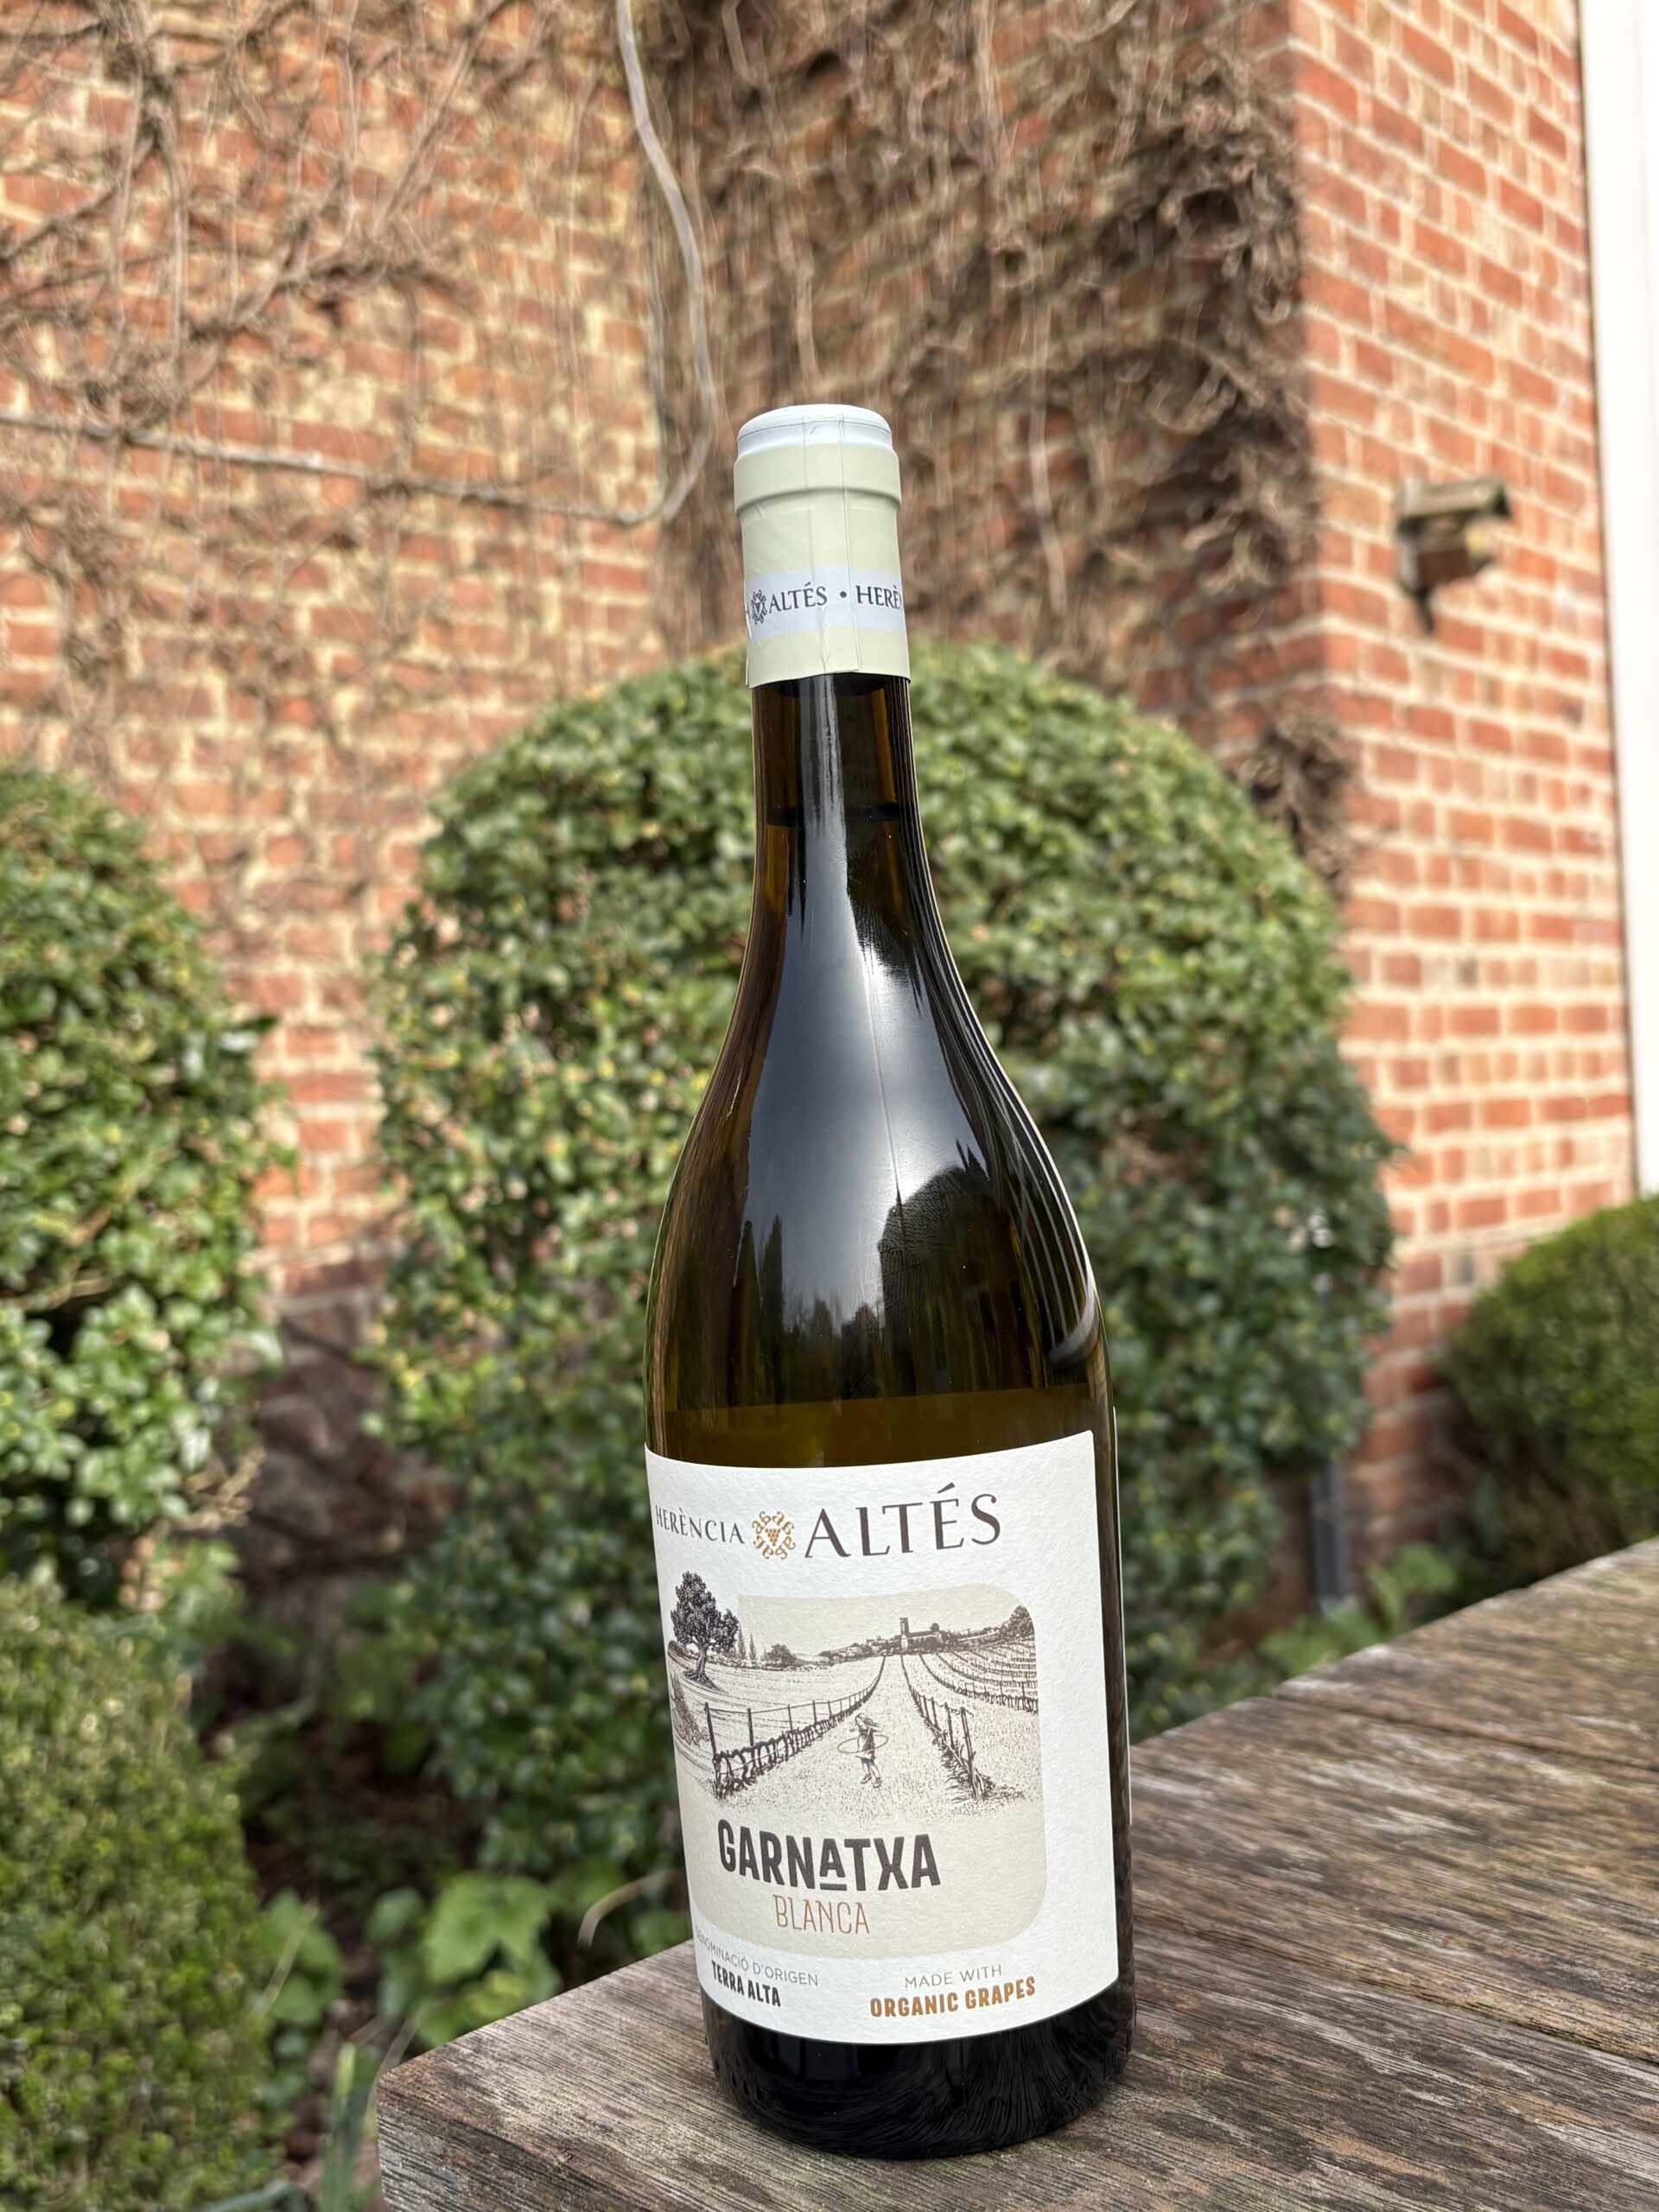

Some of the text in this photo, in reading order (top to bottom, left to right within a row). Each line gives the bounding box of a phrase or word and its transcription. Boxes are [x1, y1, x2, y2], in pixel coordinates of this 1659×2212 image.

[769, 582, 827, 613] ALTÉS
[655, 1482, 1001, 1558] HERÈNCIA ALTÉS
[718, 1819, 941, 1891] GARNATXA
[772, 1894, 870, 1935] BLANCA
[711, 1959, 782, 2007] TERRA ALTA
[753, 1961, 818, 1987] D'ORIGEN
[905, 1964, 1002, 1989] MADE WITH
[869, 1975, 1036, 2018] ORGANIC GRAPES
